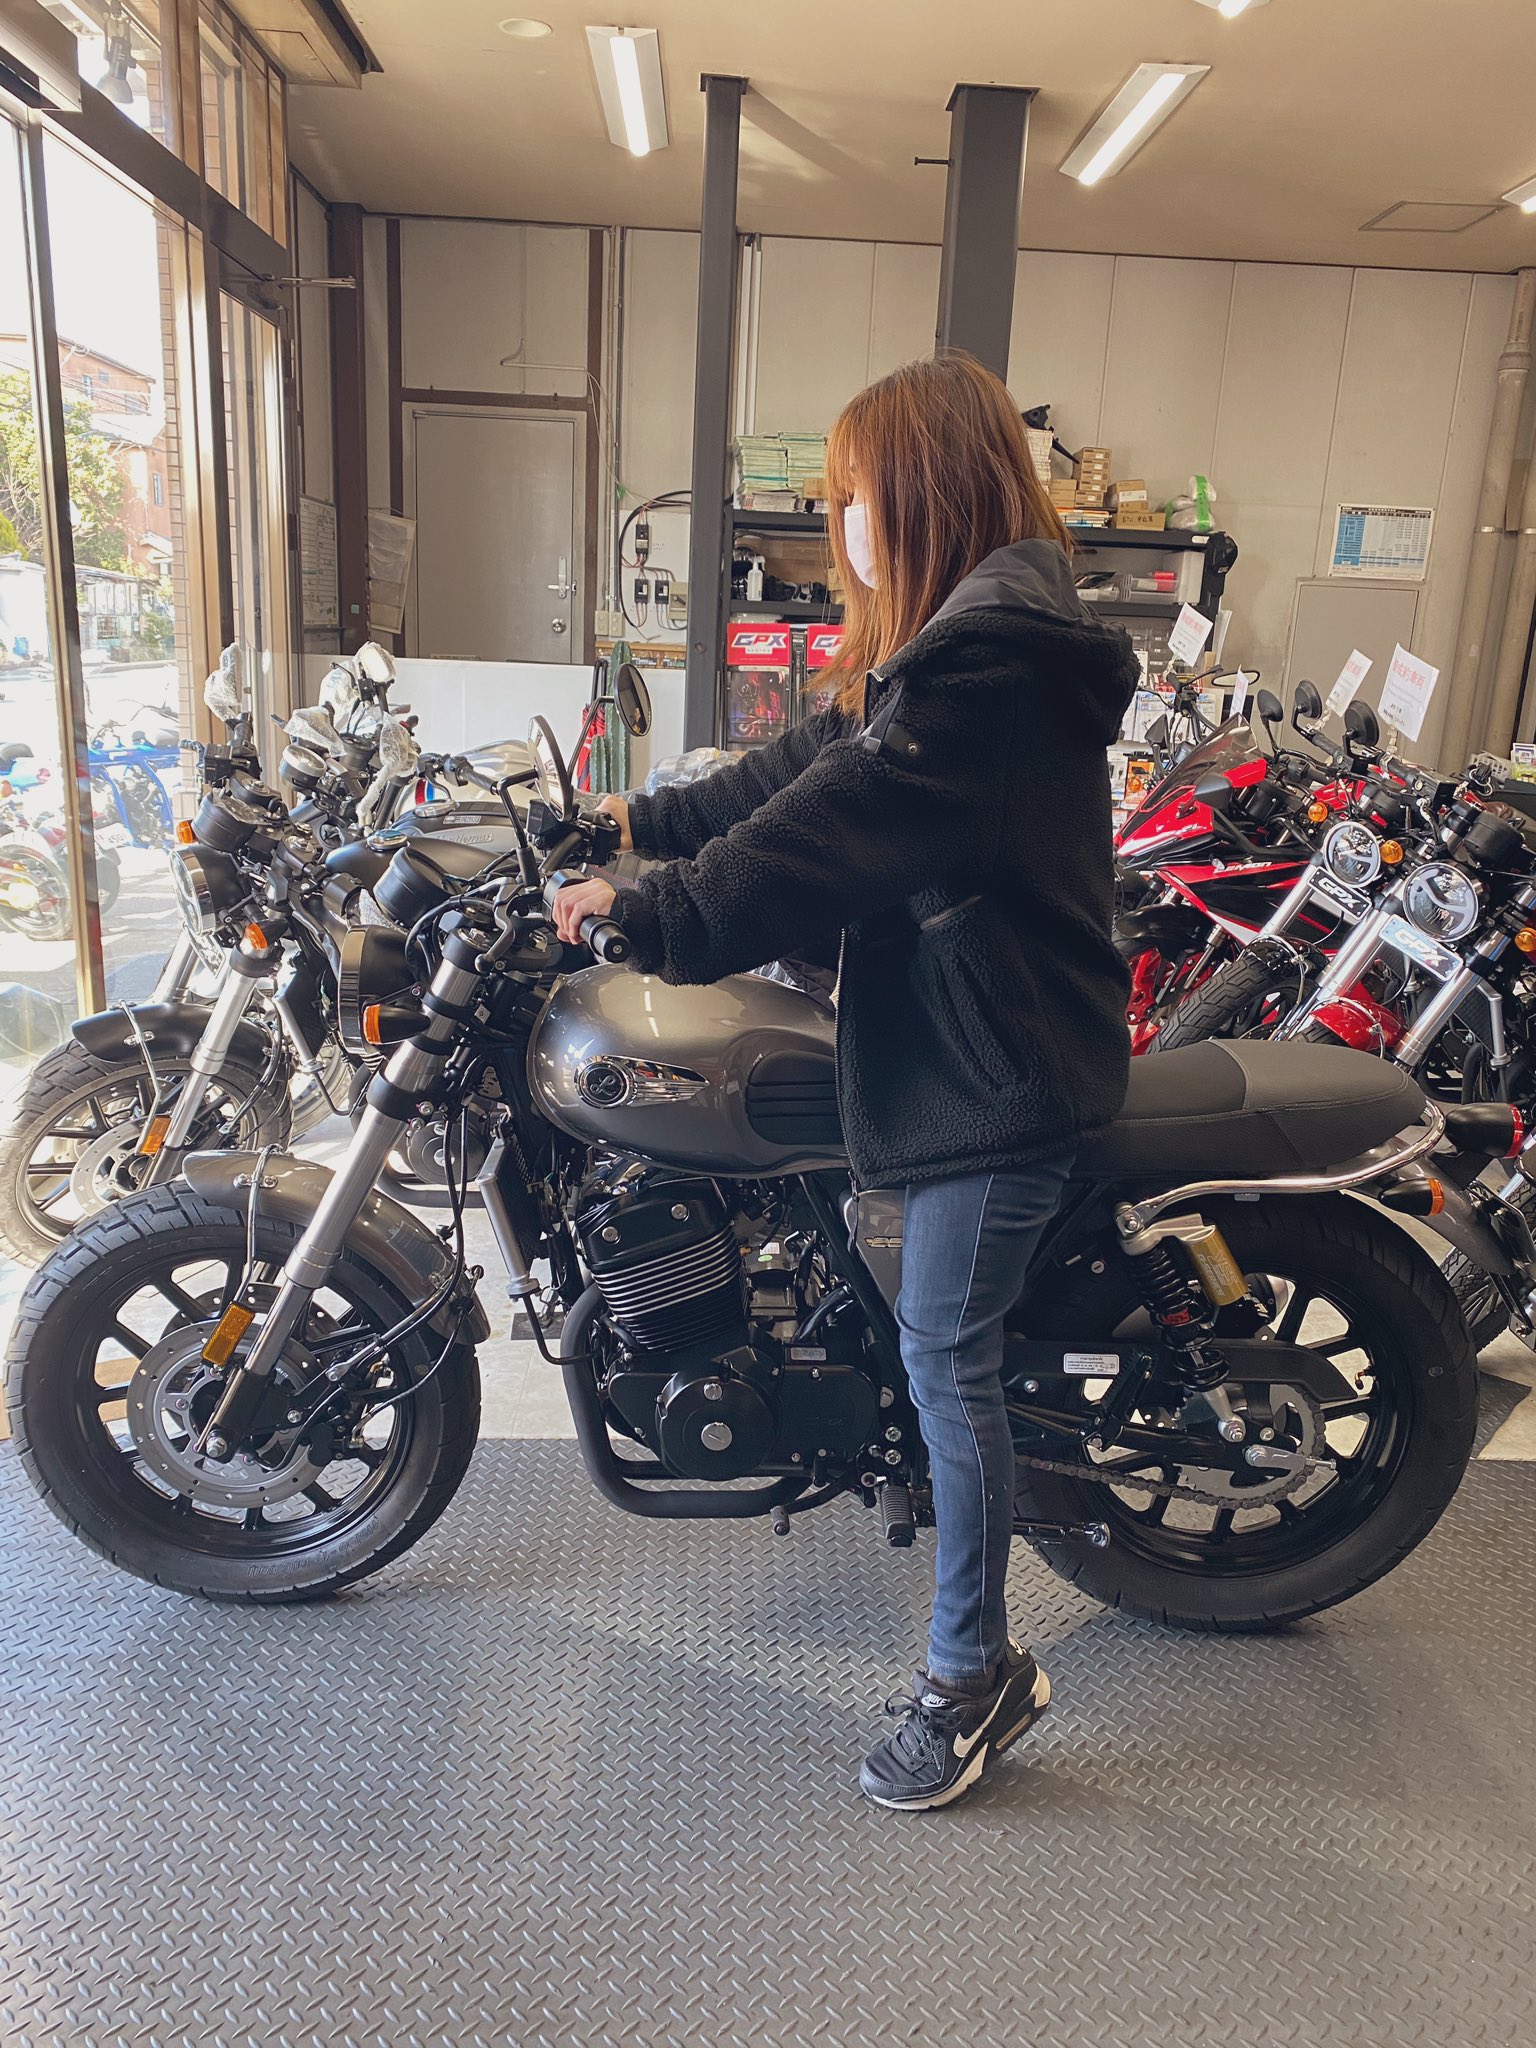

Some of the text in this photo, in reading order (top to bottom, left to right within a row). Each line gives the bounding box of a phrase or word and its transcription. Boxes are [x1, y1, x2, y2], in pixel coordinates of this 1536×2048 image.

[732, 632, 786, 648] GPX
[812, 635, 843, 650] GP
[1318, 877, 1361, 908] GPX
[1394, 928, 1448, 967] GPX
[925, 1692, 948, 1705] NIKE
